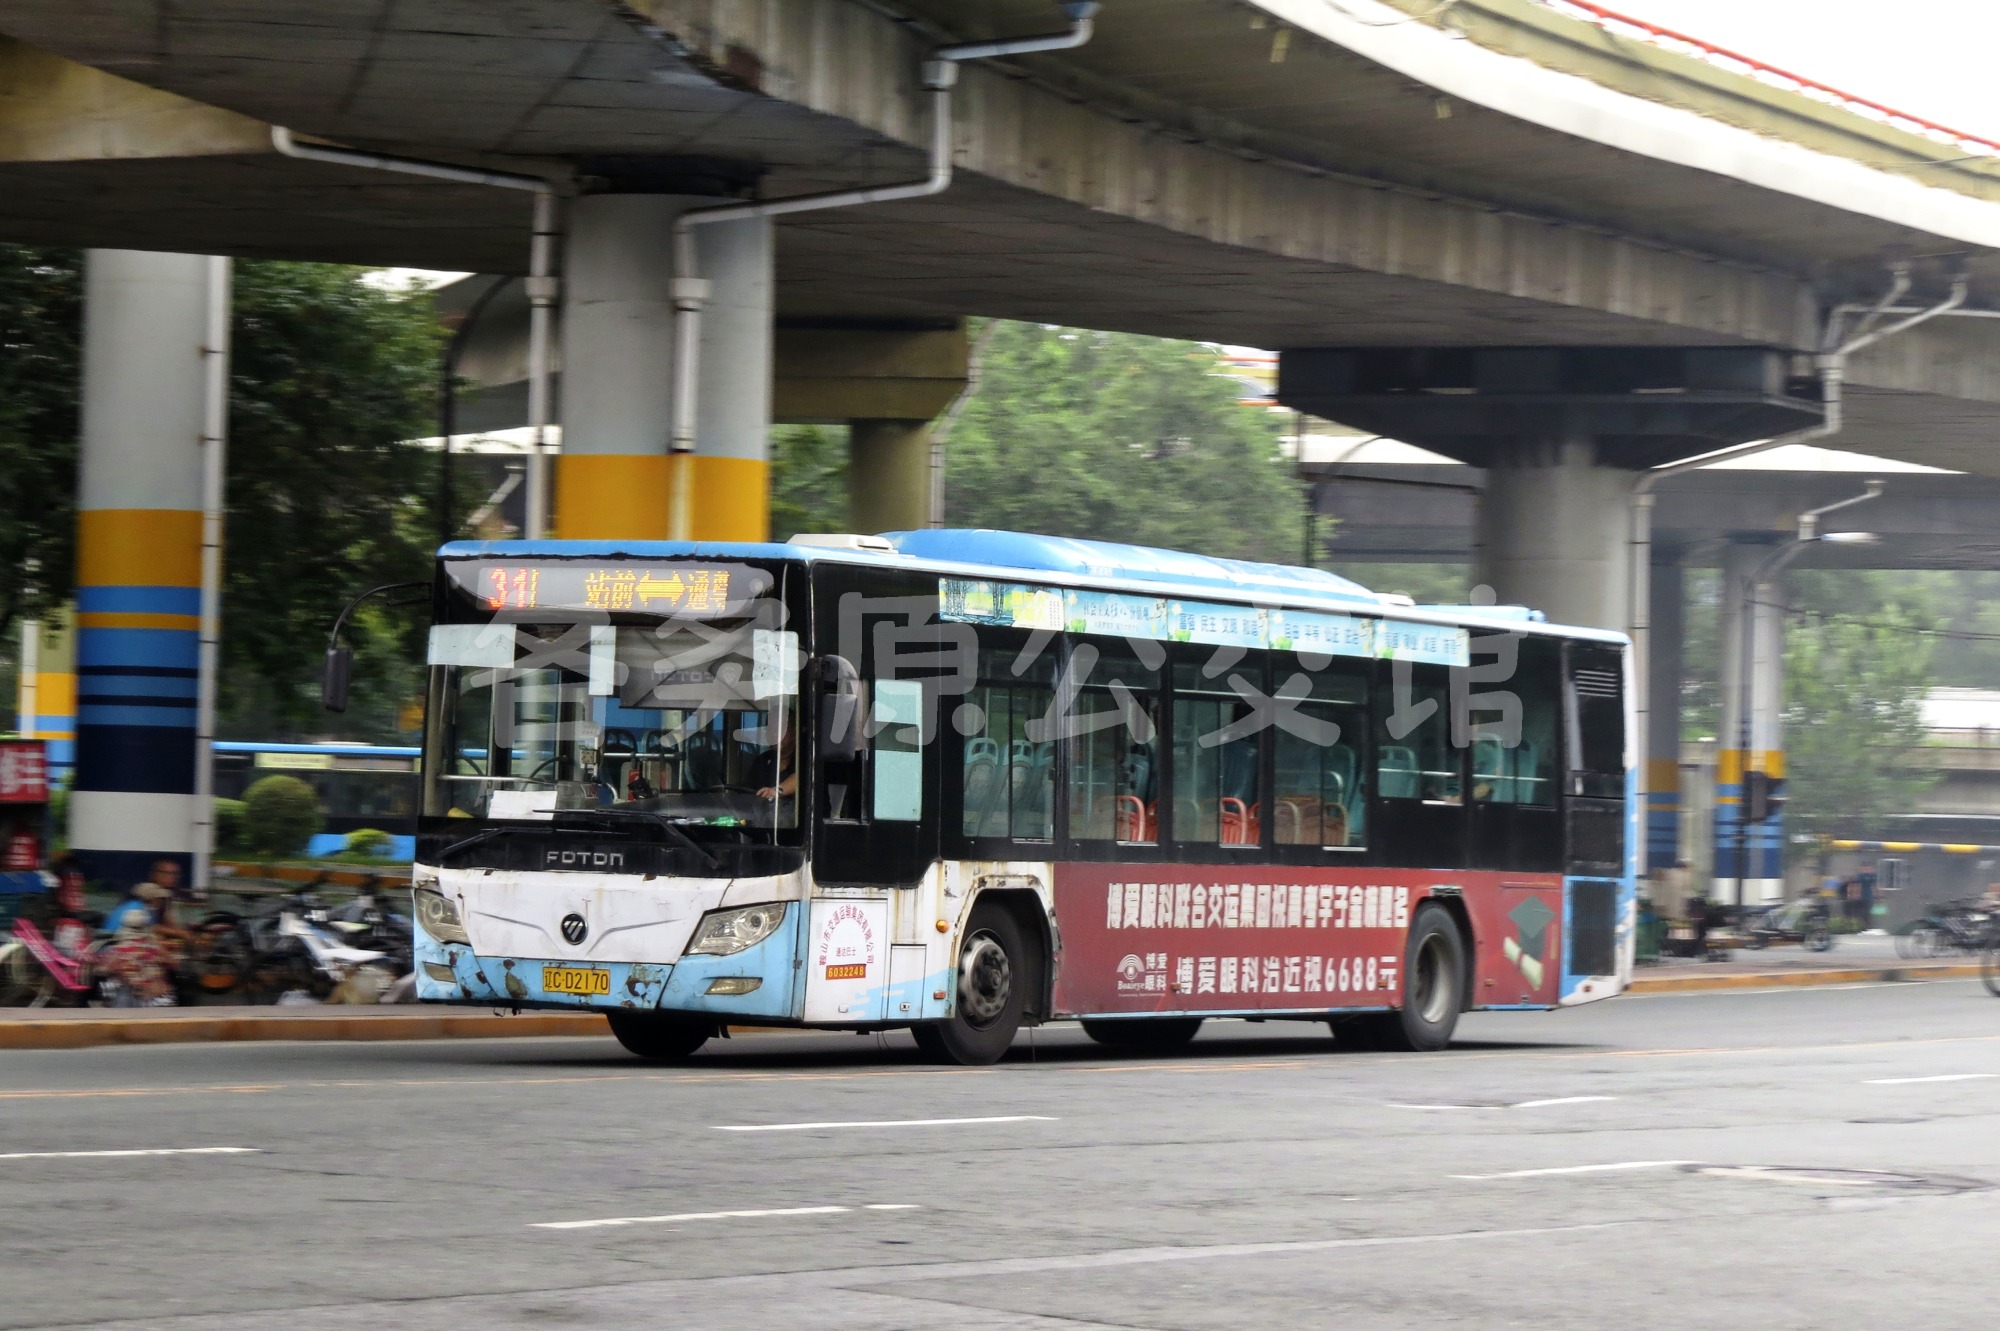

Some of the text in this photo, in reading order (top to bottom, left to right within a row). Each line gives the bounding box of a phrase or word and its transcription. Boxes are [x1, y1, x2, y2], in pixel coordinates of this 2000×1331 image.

[546, 851, 624, 866] FOTON
[827, 966, 865, 978] 6032248
[1175, 956, 1398, 995] 博爱眼科治近视6688元
